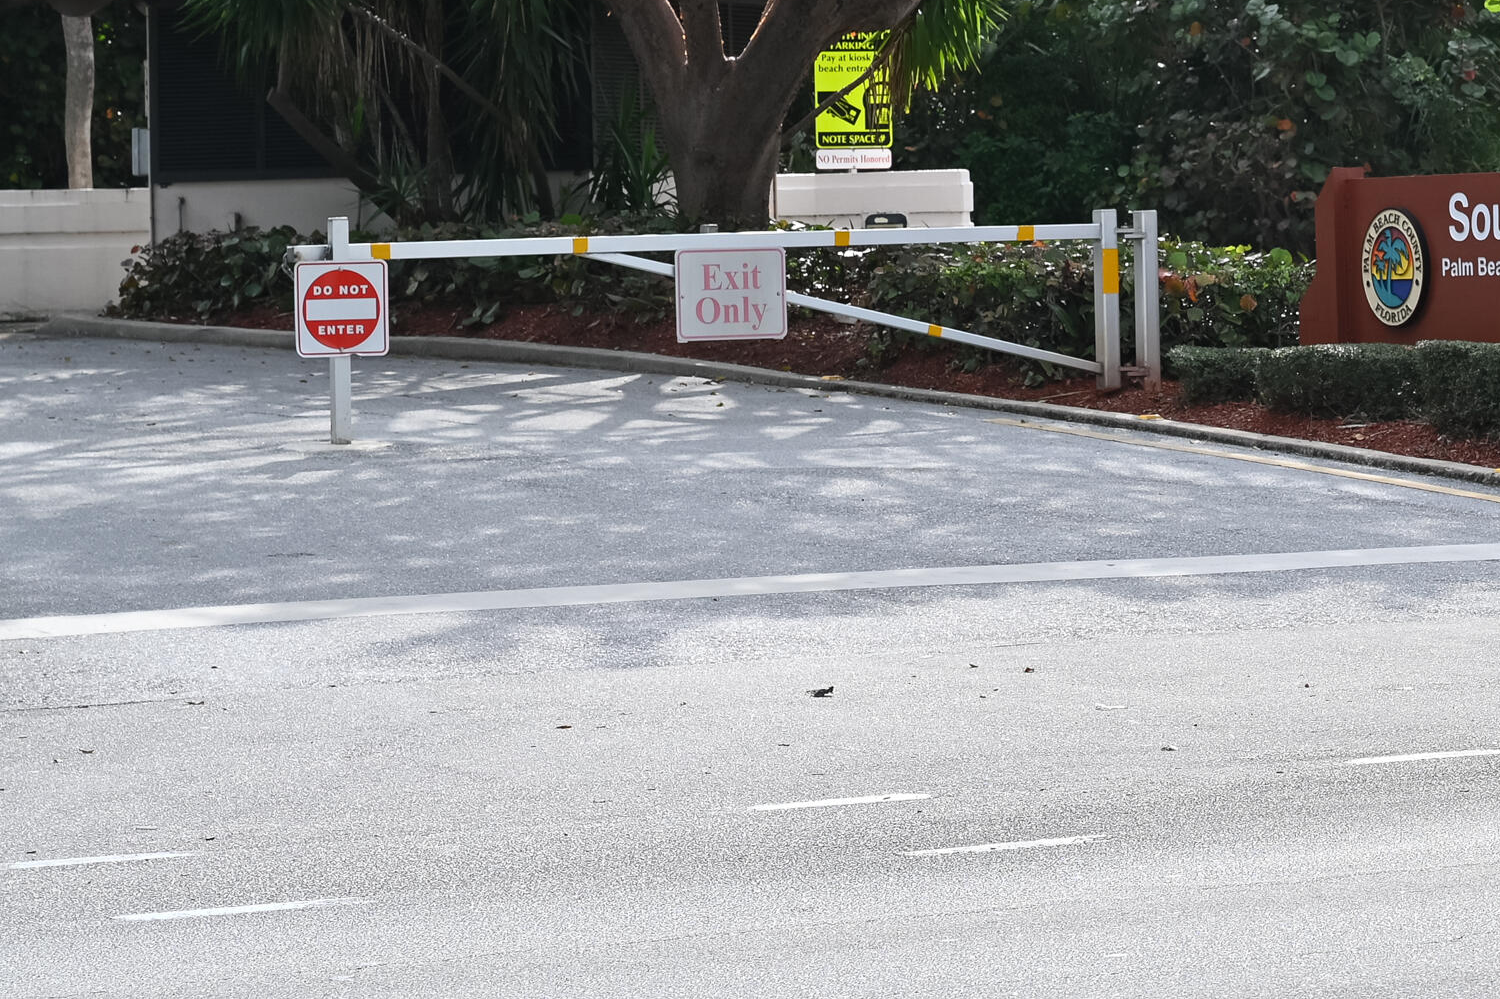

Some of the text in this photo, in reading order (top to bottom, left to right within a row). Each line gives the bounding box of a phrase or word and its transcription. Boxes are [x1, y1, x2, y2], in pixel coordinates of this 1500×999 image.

[821, 54, 836, 62] Pay
[818, 65, 844, 73] beach
[822, 135, 847, 143] NOTE
[849, 134, 876, 143] SPACE
[818, 154, 890, 164] NO Permits Honored
[1363, 213, 1422, 273] PALM BEACH COUNTY
[1441, 257, 1474, 277] Palm
[702, 263, 761, 290] Exit
[313, 284, 369, 296] DO NOT
[696, 296, 767, 330] Only
[1375, 304, 1412, 323] FLORIDA
[318, 324, 365, 335] ENTER
